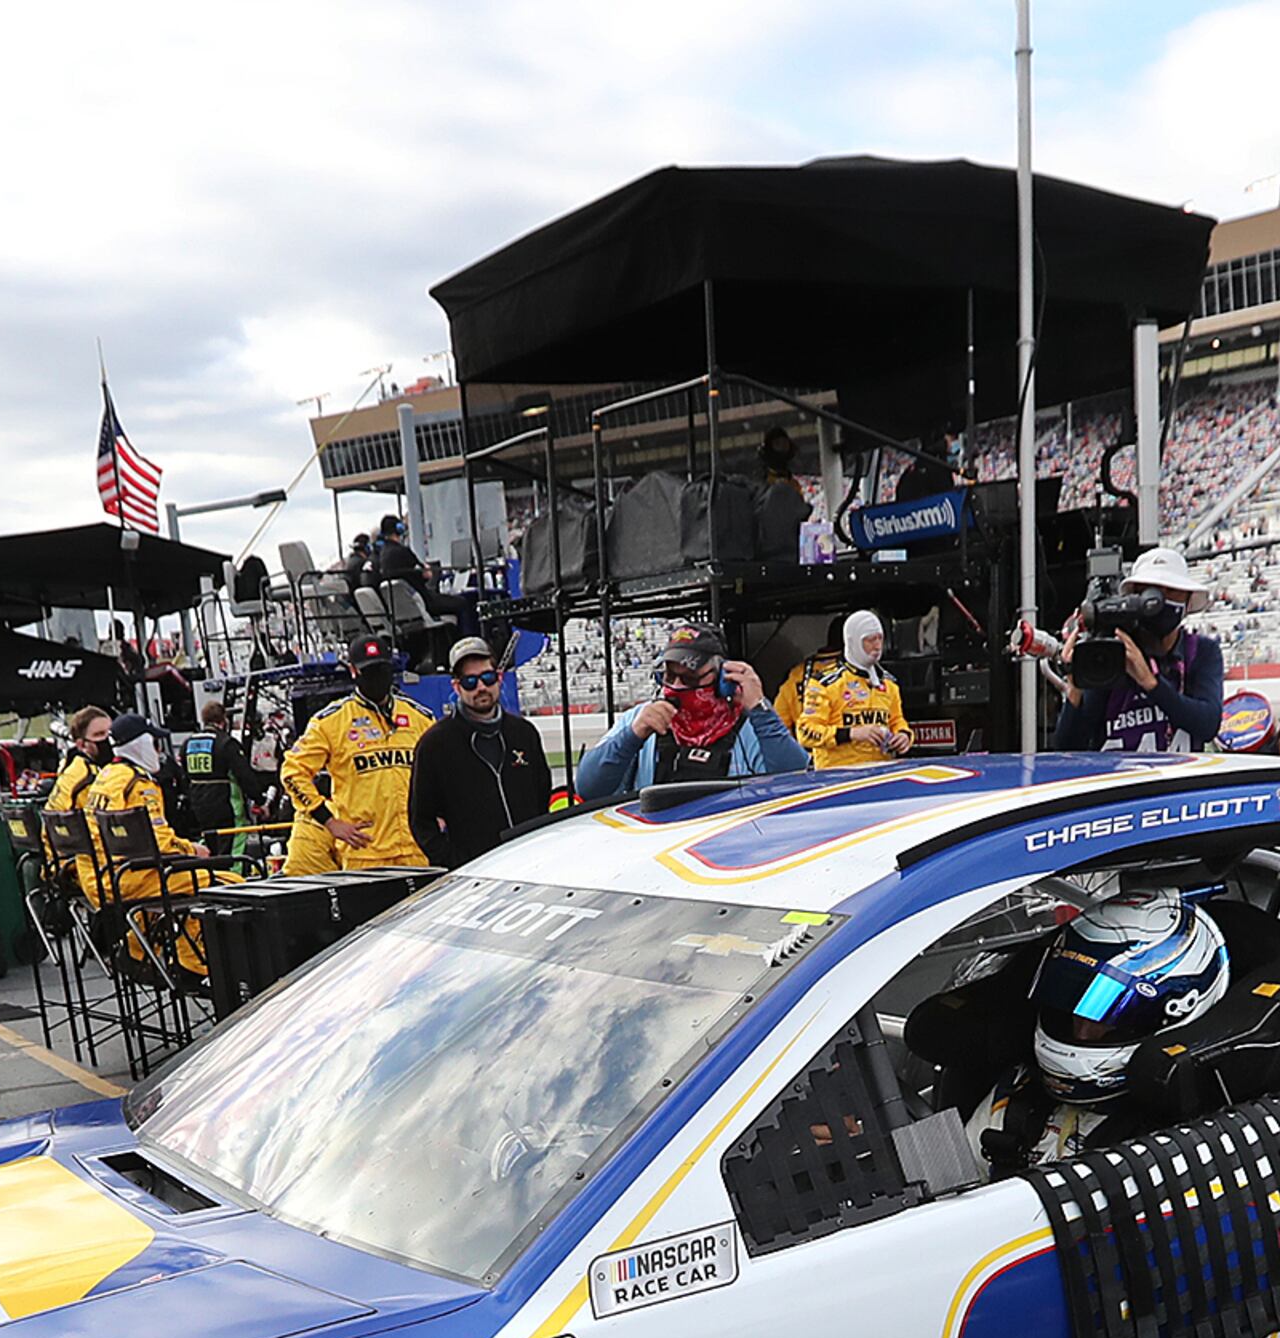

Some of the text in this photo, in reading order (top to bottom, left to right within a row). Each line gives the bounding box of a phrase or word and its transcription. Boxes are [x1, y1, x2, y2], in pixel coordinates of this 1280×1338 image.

[19, 659, 83, 679] HAAS
[353, 748, 414, 773] DEWAL
[1024, 794, 1272, 853] CHASE ELLIOTT
[635, 1234, 718, 1276] NASCAR
[614, 1262, 719, 1304] RACE CAR
